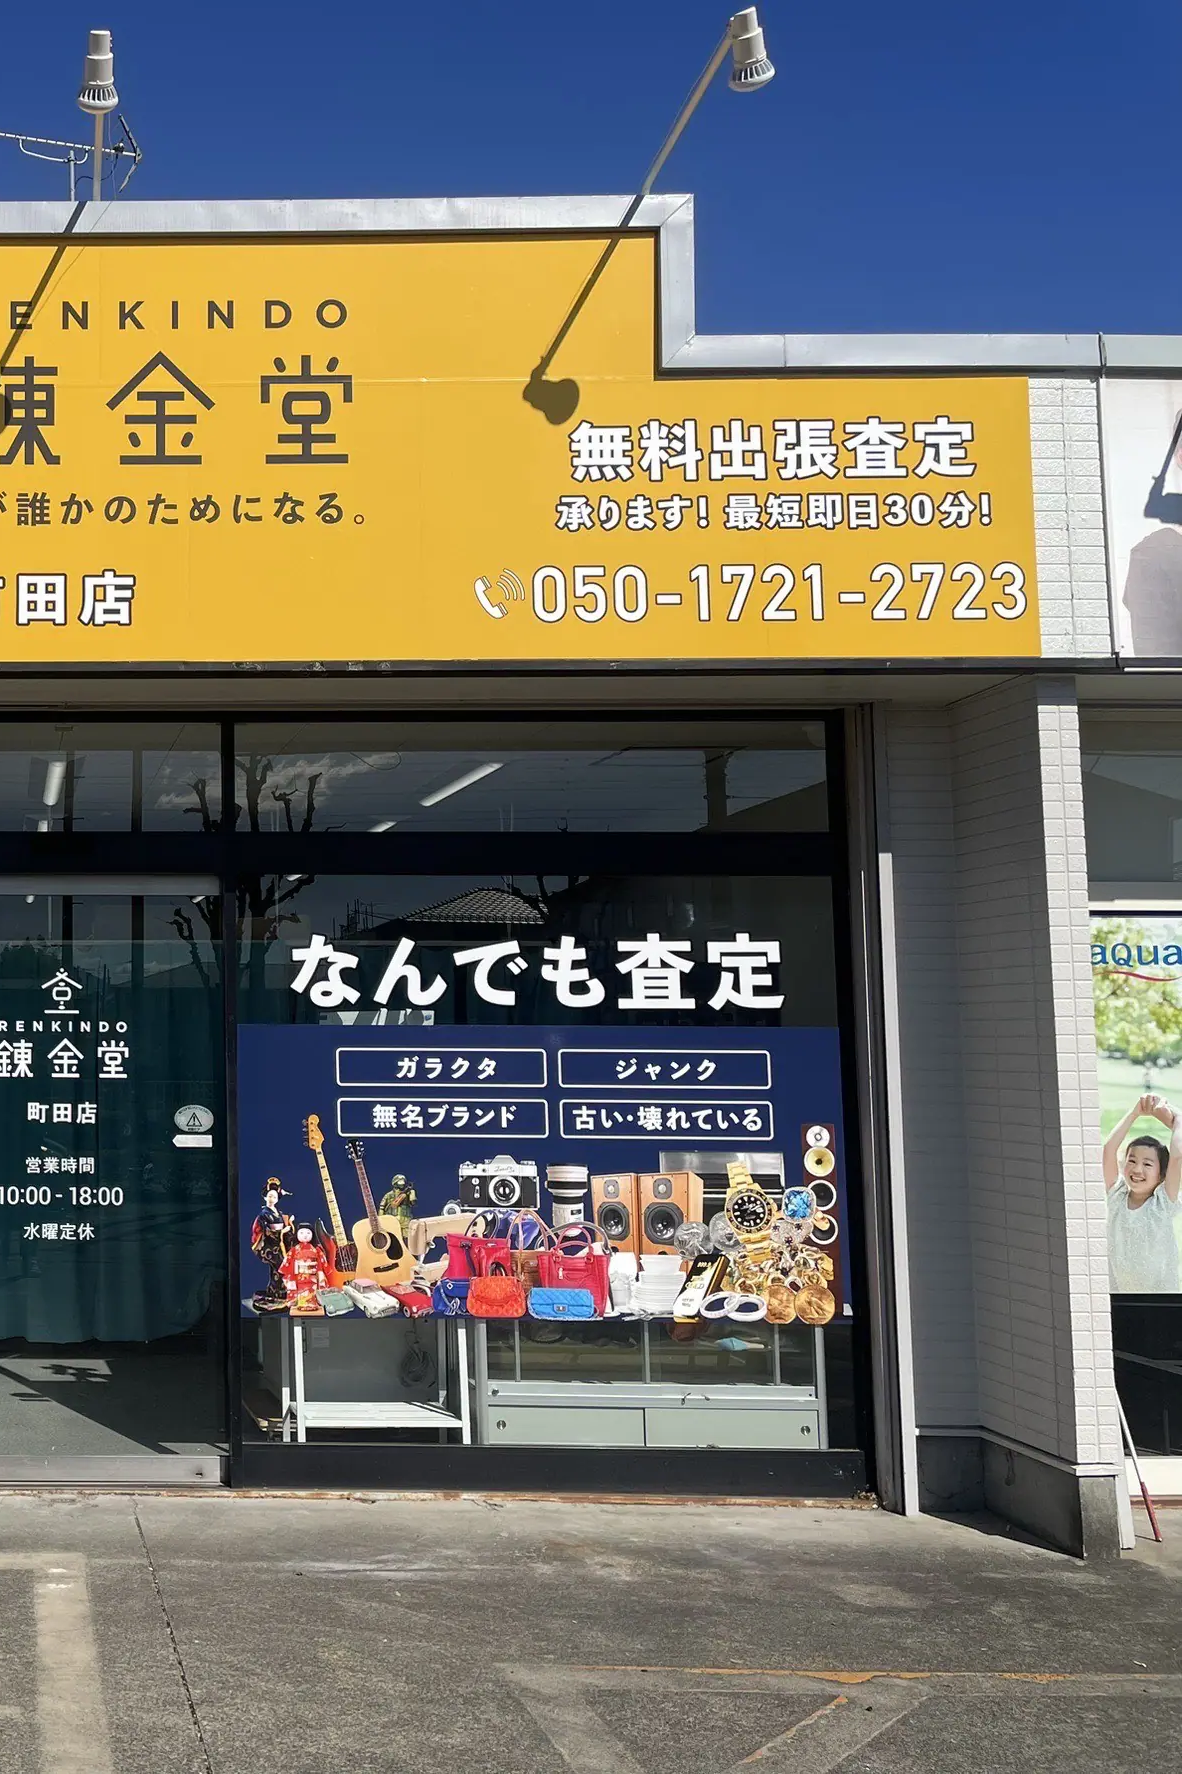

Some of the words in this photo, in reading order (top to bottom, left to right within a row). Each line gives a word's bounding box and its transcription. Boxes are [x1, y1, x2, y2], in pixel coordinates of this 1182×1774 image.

[568, 416, 978, 483] 無料出張査定
[533, 562, 1027, 623] 050-1721-2723
[291, 933, 785, 1010] なんでも査定
[396, 1056, 496, 1079] ガラクタ
[616, 1058, 716, 1080] ジャンク
[28, 1102, 97, 1124] 町田店
[373, 1104, 516, 1128] 無名ブランド
[26, 1157, 94, 1174] 営業時間
[24, 1223, 94, 1240] 水曜定休
